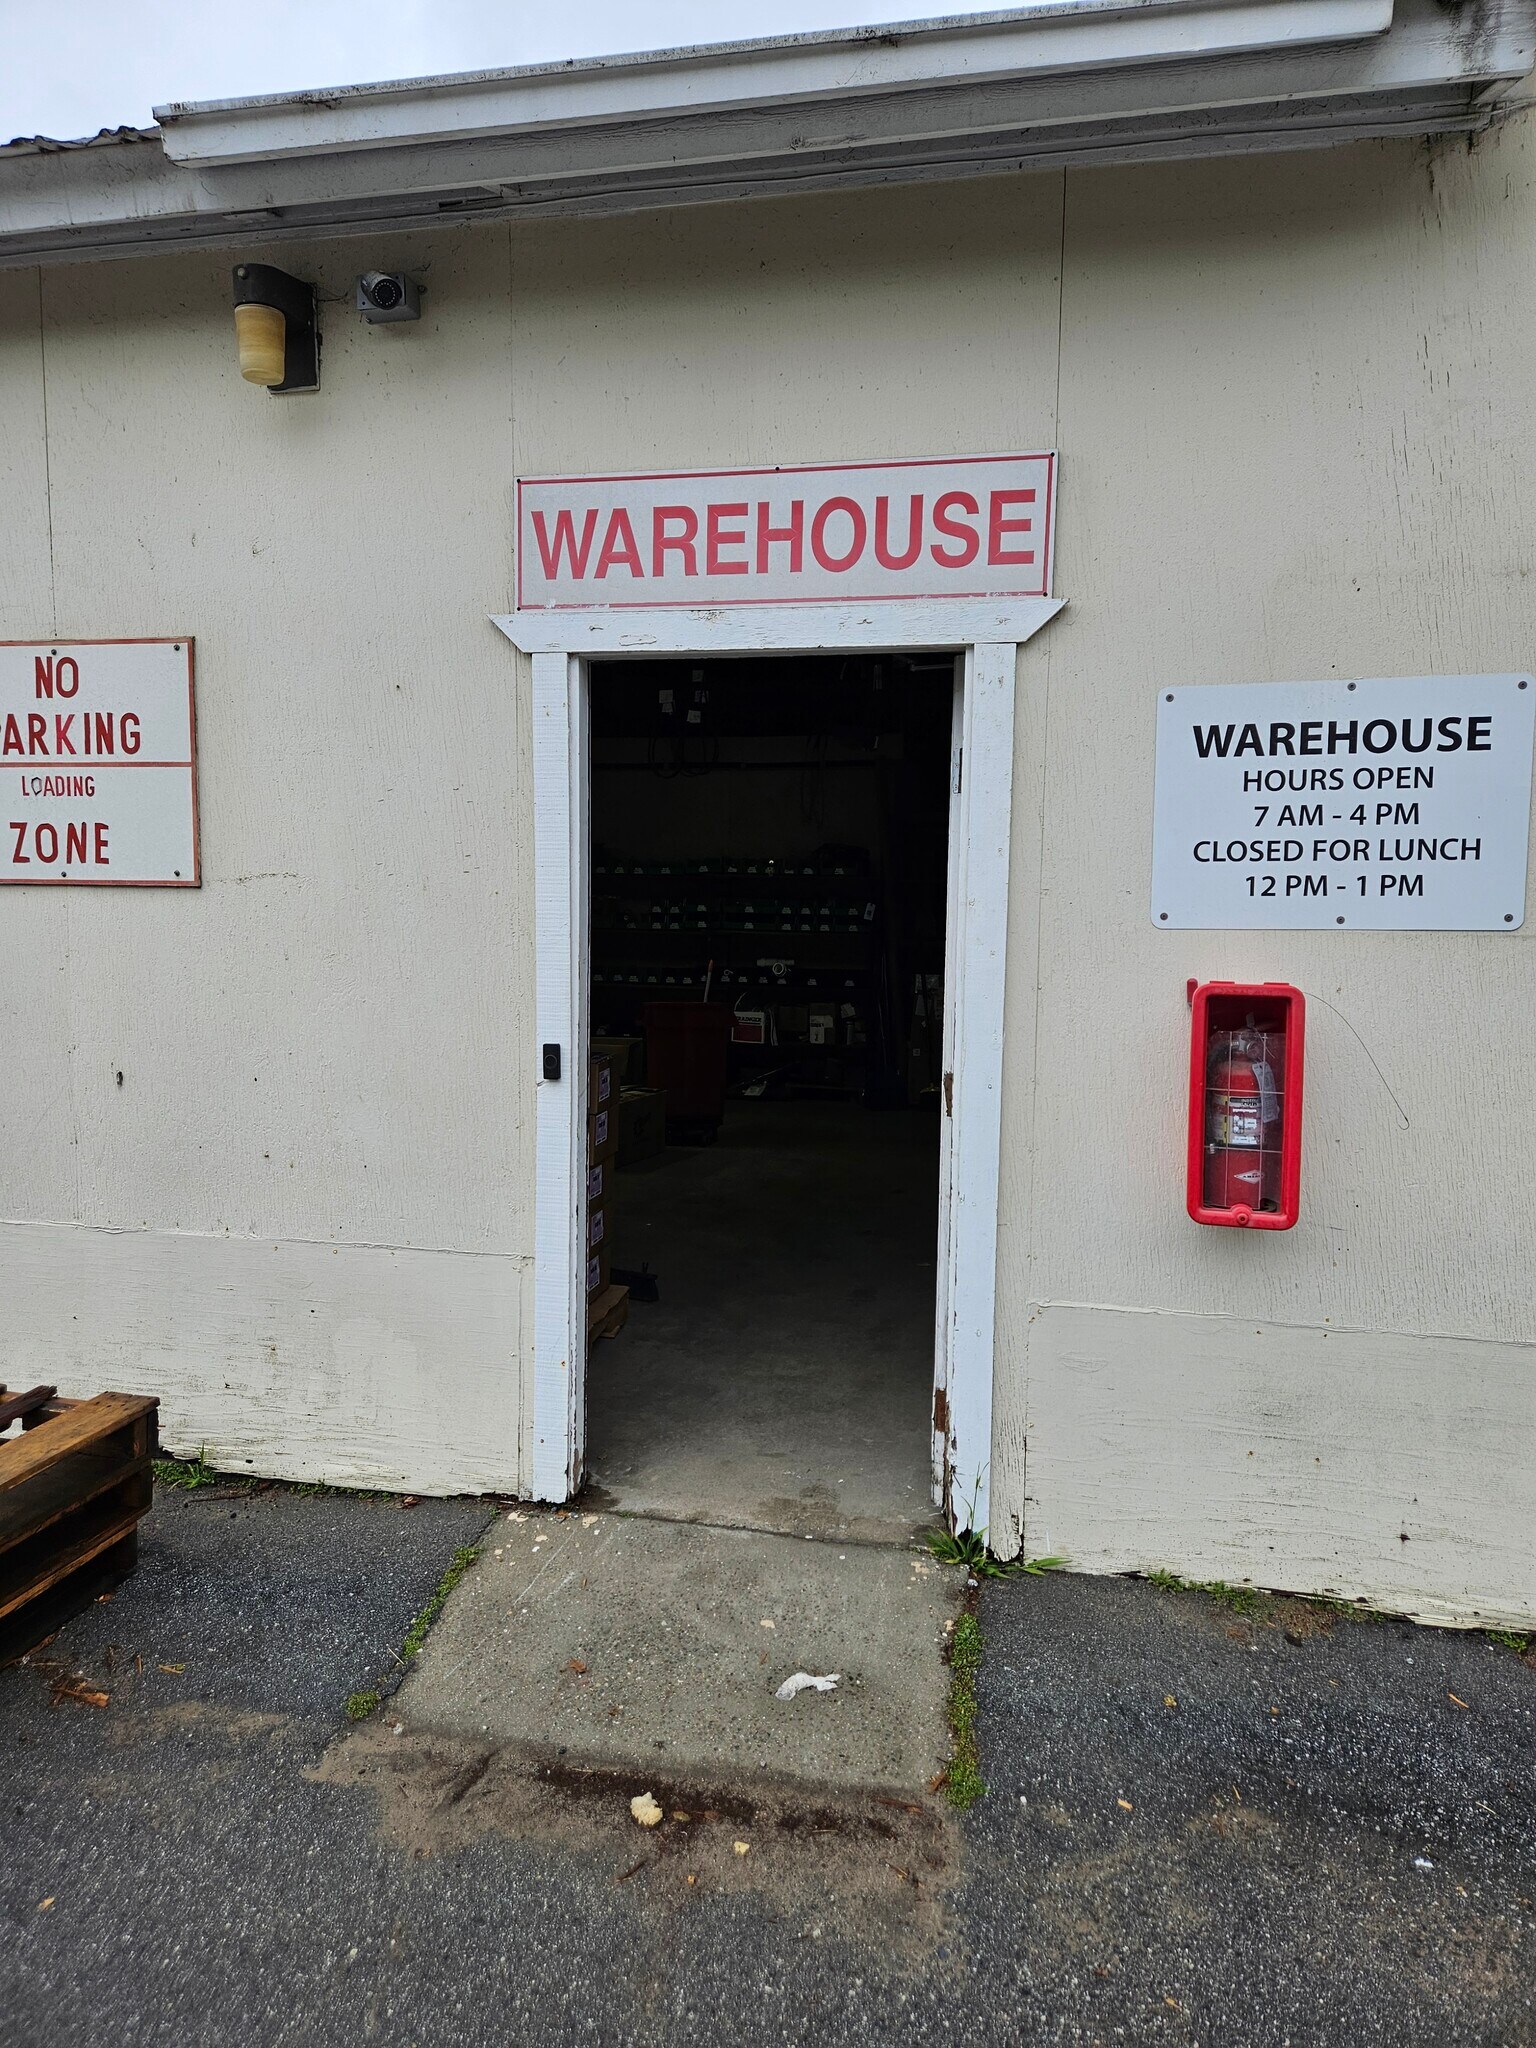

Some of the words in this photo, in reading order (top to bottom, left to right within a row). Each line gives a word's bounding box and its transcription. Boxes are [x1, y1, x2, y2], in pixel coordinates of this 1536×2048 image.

[531, 488, 1036, 580] WAREHOUSE
[35, 656, 79, 699] NO
[0, 712, 141, 755] ARKING
[1193, 715, 1493, 759] WAREHOUSE
[21, 775, 95, 798] LOADING
[1243, 767, 1344, 793] HOURS
[1353, 766, 1434, 790] OPEN
[1254, 805, 1270, 827] 7
[1276, 804, 1324, 827] AM
[1349, 804, 1367, 826] 4
[1375, 802, 1420, 826] PM
[9, 821, 109, 865] ZONE
[1193, 839, 1304, 863] CLOSED
[1312, 839, 1371, 862] FOR
[1379, 837, 1482, 862] LUNCH
[1245, 875, 1276, 897] 12
[1285, 874, 1328, 897] PM
[1356, 875, 1367, 897] 1
[1379, 874, 1424, 897] PM
